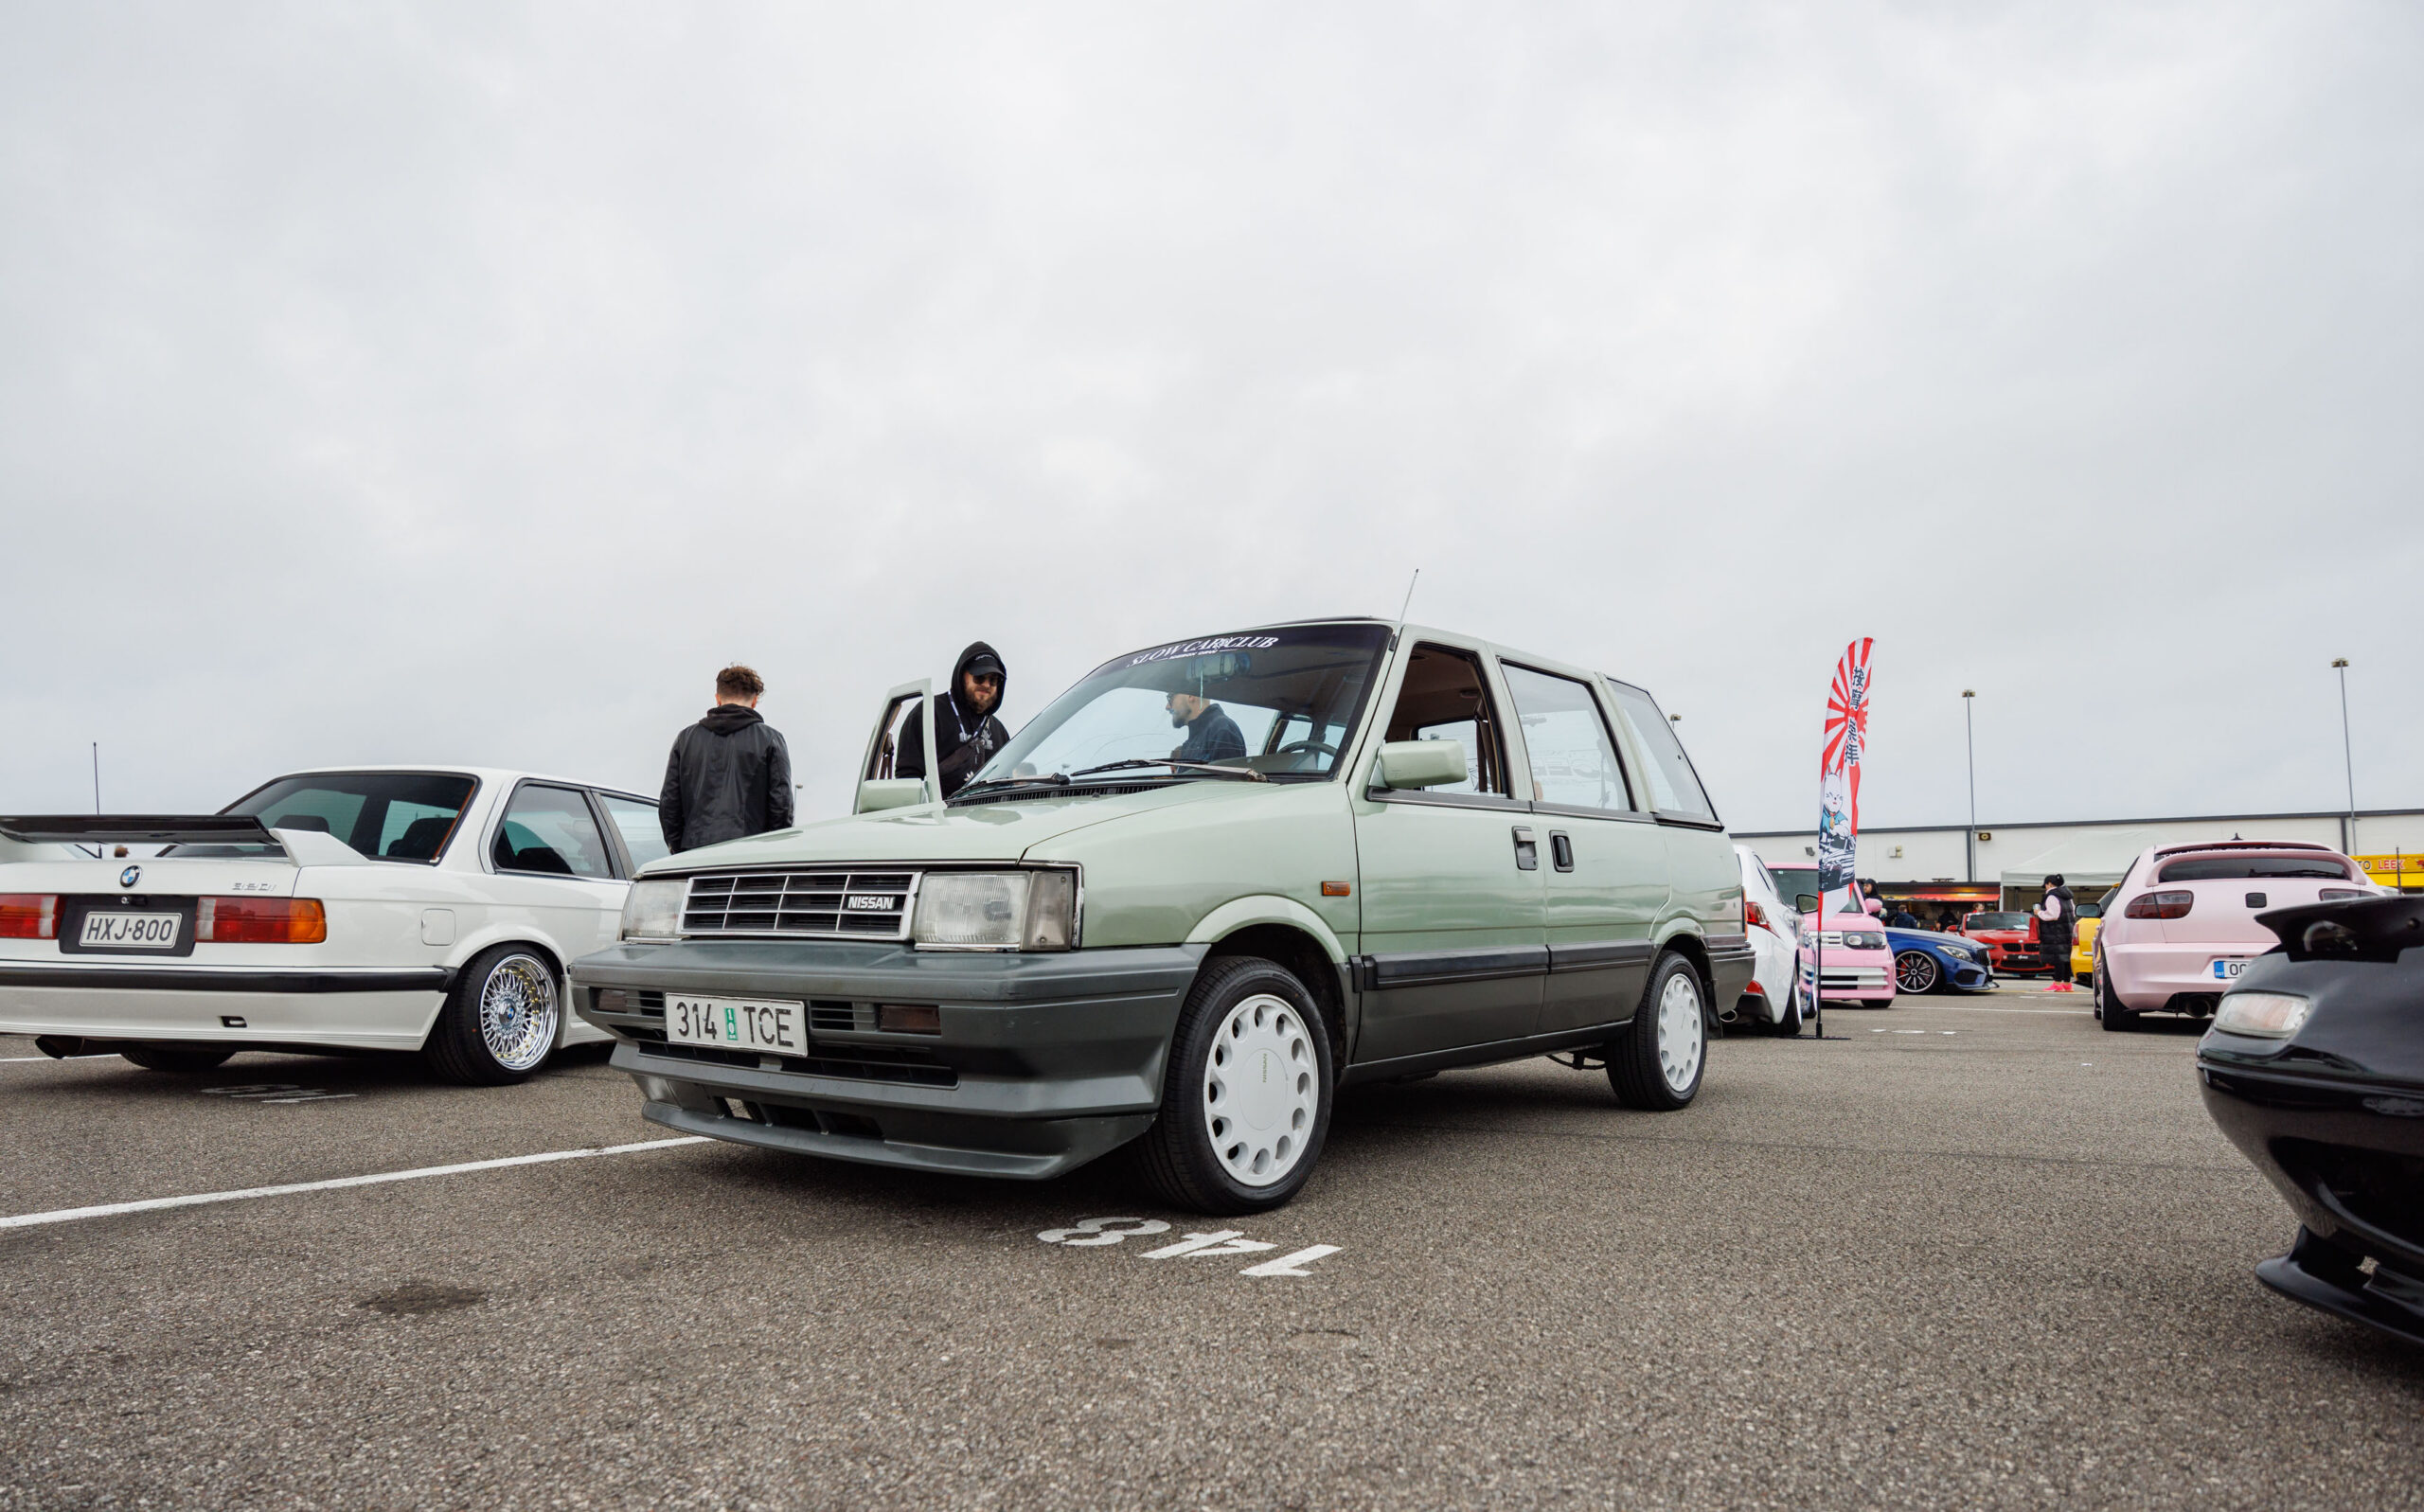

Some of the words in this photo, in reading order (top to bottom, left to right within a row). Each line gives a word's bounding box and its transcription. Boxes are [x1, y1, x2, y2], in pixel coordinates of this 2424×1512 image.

[1126, 643, 1184, 667] SLOW
[1184, 637, 1223, 653] CAR
[1226, 636, 1279, 649] CLUB
[2378, 859, 2406, 870] LEEK
[847, 896, 896, 911] NISSAN
[86, 917, 173, 942] HXJ-800
[676, 1001, 718, 1040] 314
[743, 1005, 794, 1047] TCE
[1037, 1216, 1344, 1277] 148
